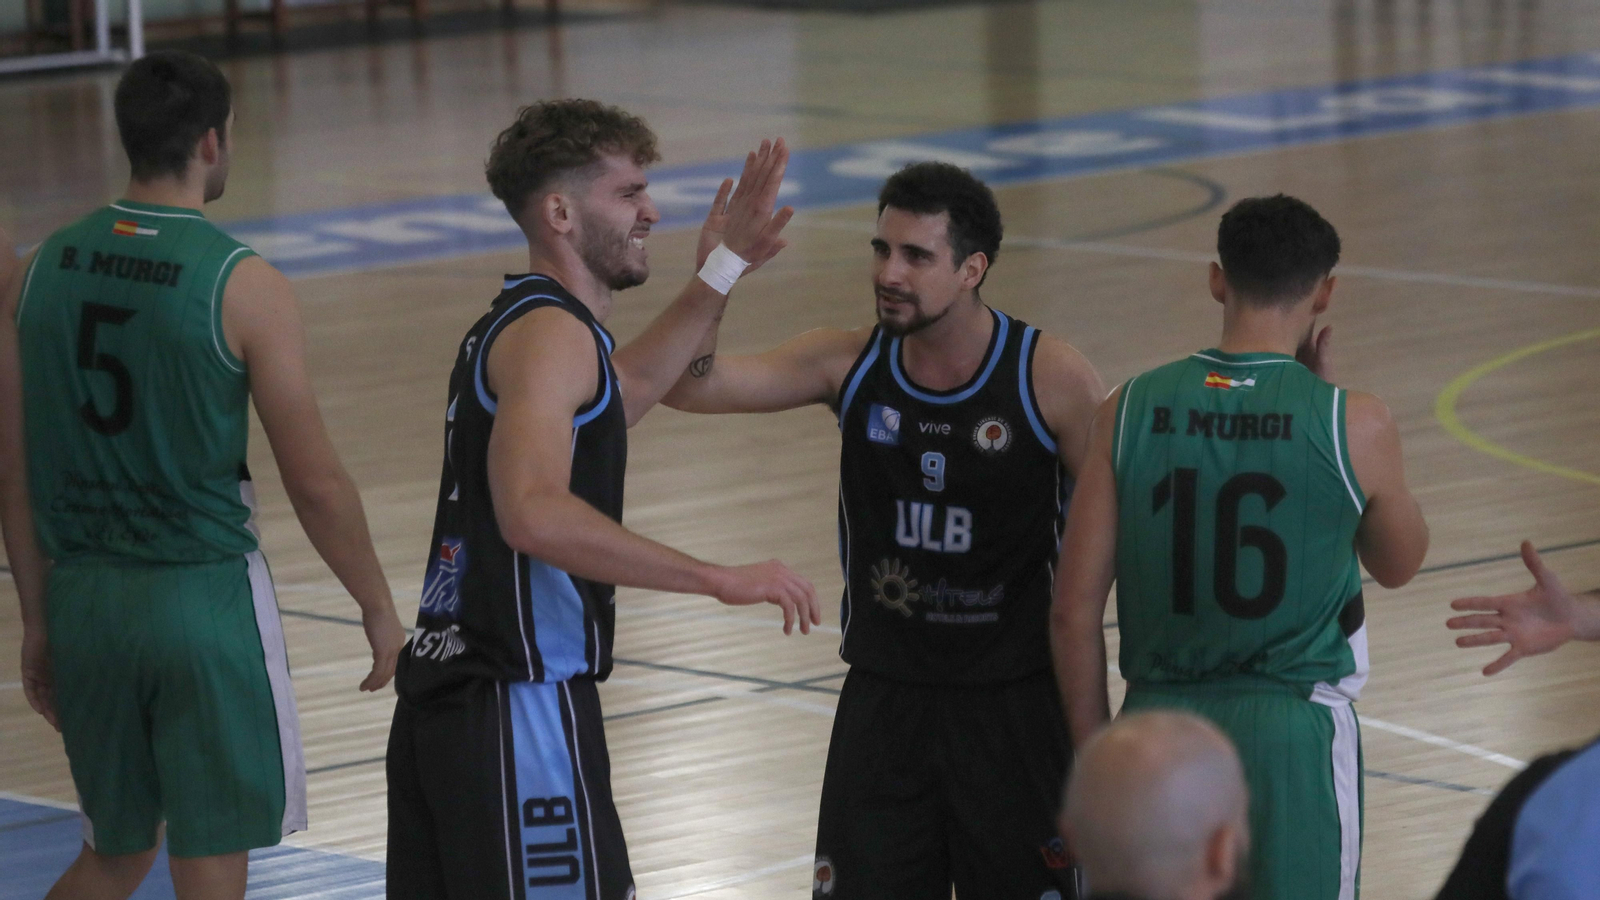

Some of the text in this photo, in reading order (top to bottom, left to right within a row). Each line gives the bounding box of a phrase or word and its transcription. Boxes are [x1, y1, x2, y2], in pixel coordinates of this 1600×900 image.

[60, 246, 183, 288] B. MURGI
[76, 302, 139, 437] 5
[869, 428, 894, 442] EBA
[918, 420, 951, 435] vive
[1151, 406, 1294, 441] B. MURGI
[921, 451, 946, 492] 9
[895, 500, 973, 553] ULB
[1152, 467, 1288, 620] 16
[523, 796, 580, 887] ULB
